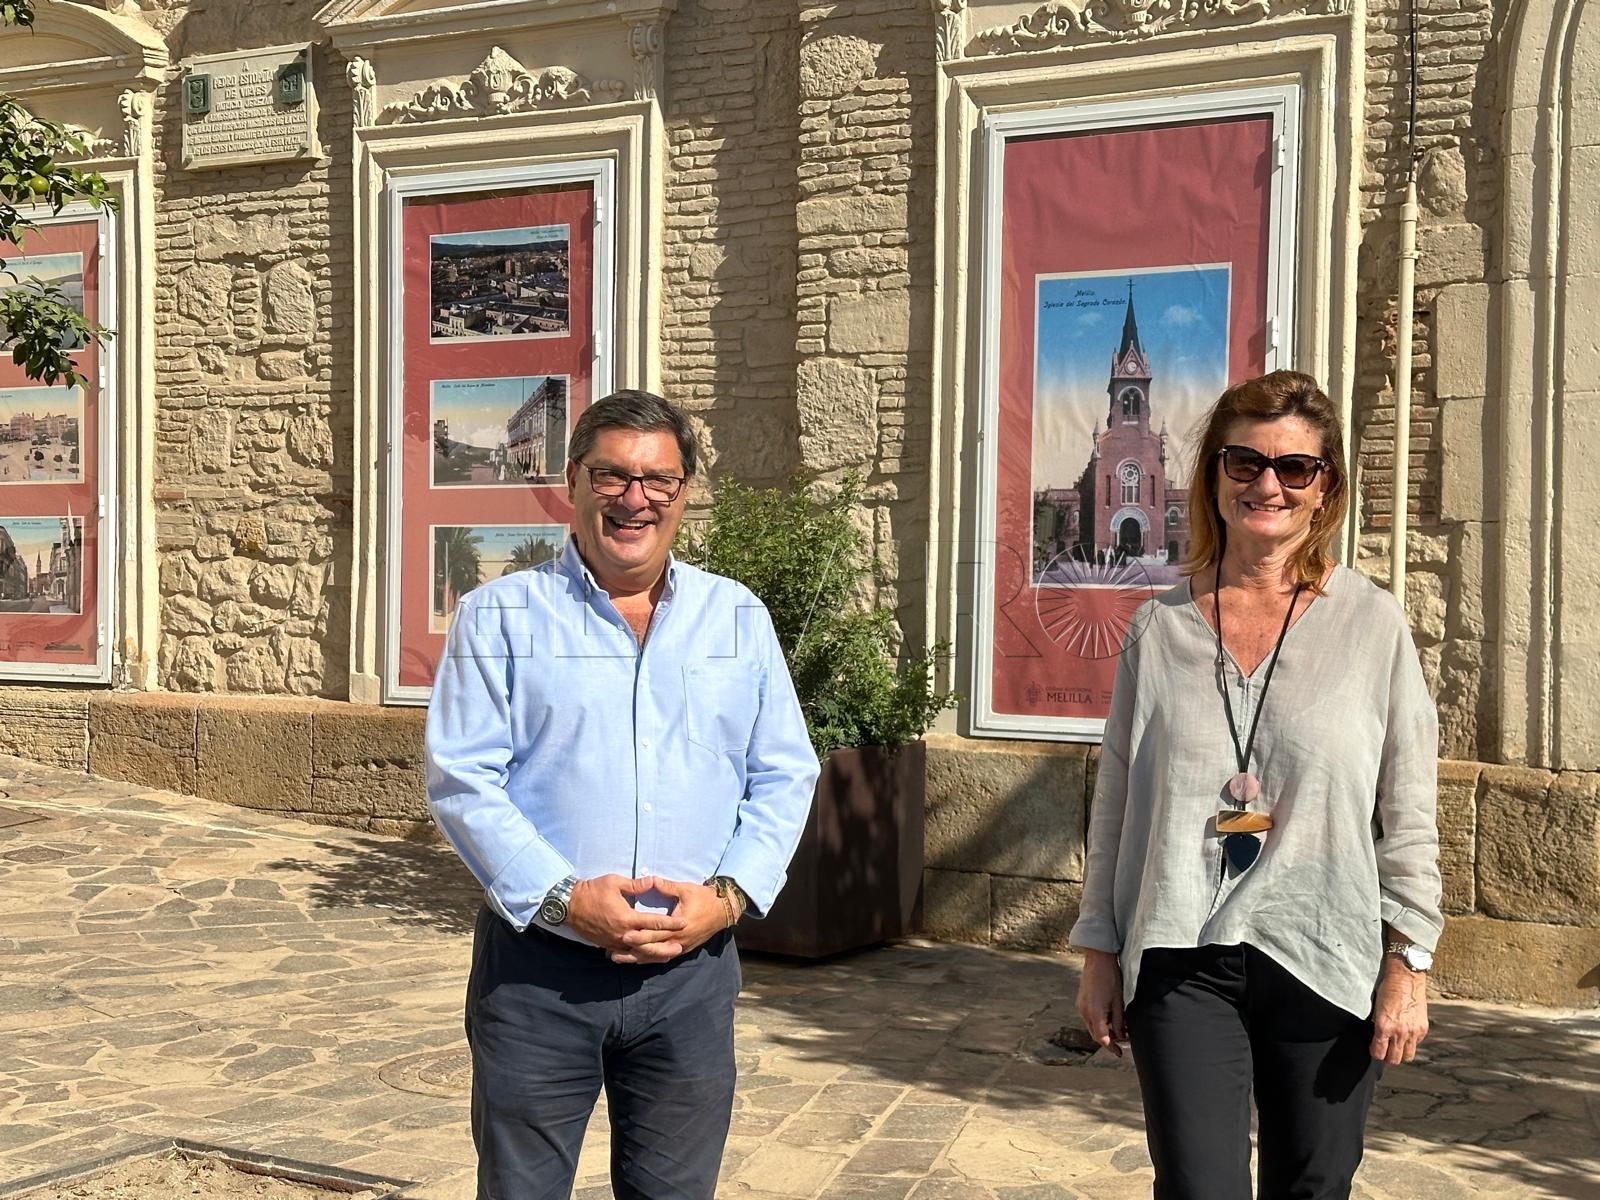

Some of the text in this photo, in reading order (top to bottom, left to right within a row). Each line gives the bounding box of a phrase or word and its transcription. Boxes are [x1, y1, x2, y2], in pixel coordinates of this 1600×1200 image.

[242, 61, 248, 72] A
[213, 75, 236, 89] PEDRO
[225, 88, 236, 100] DE
[1047, 692, 1093, 704] MELILLA
